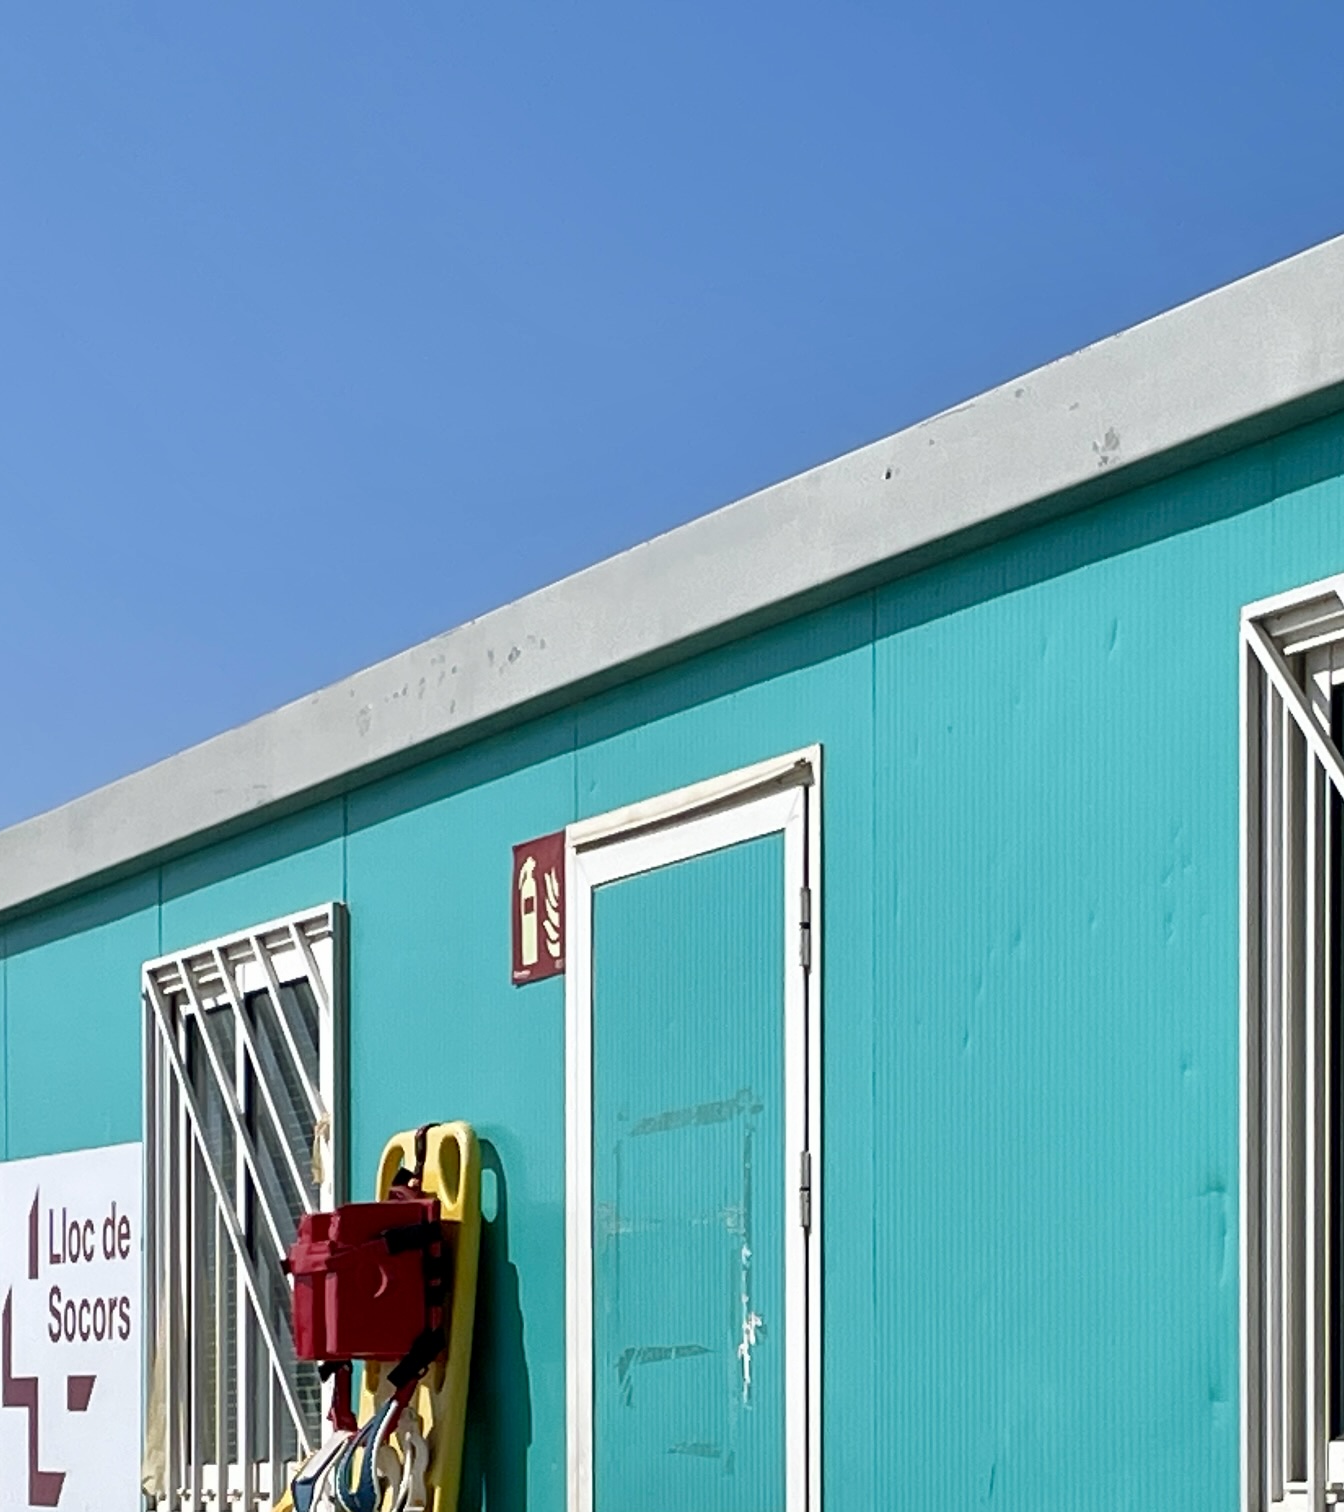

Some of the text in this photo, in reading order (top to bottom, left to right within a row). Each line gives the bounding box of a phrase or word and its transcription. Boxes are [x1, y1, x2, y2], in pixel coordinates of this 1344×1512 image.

[48, 1200, 131, 1265] Lloc de
[47, 1284, 131, 1343] Socors
